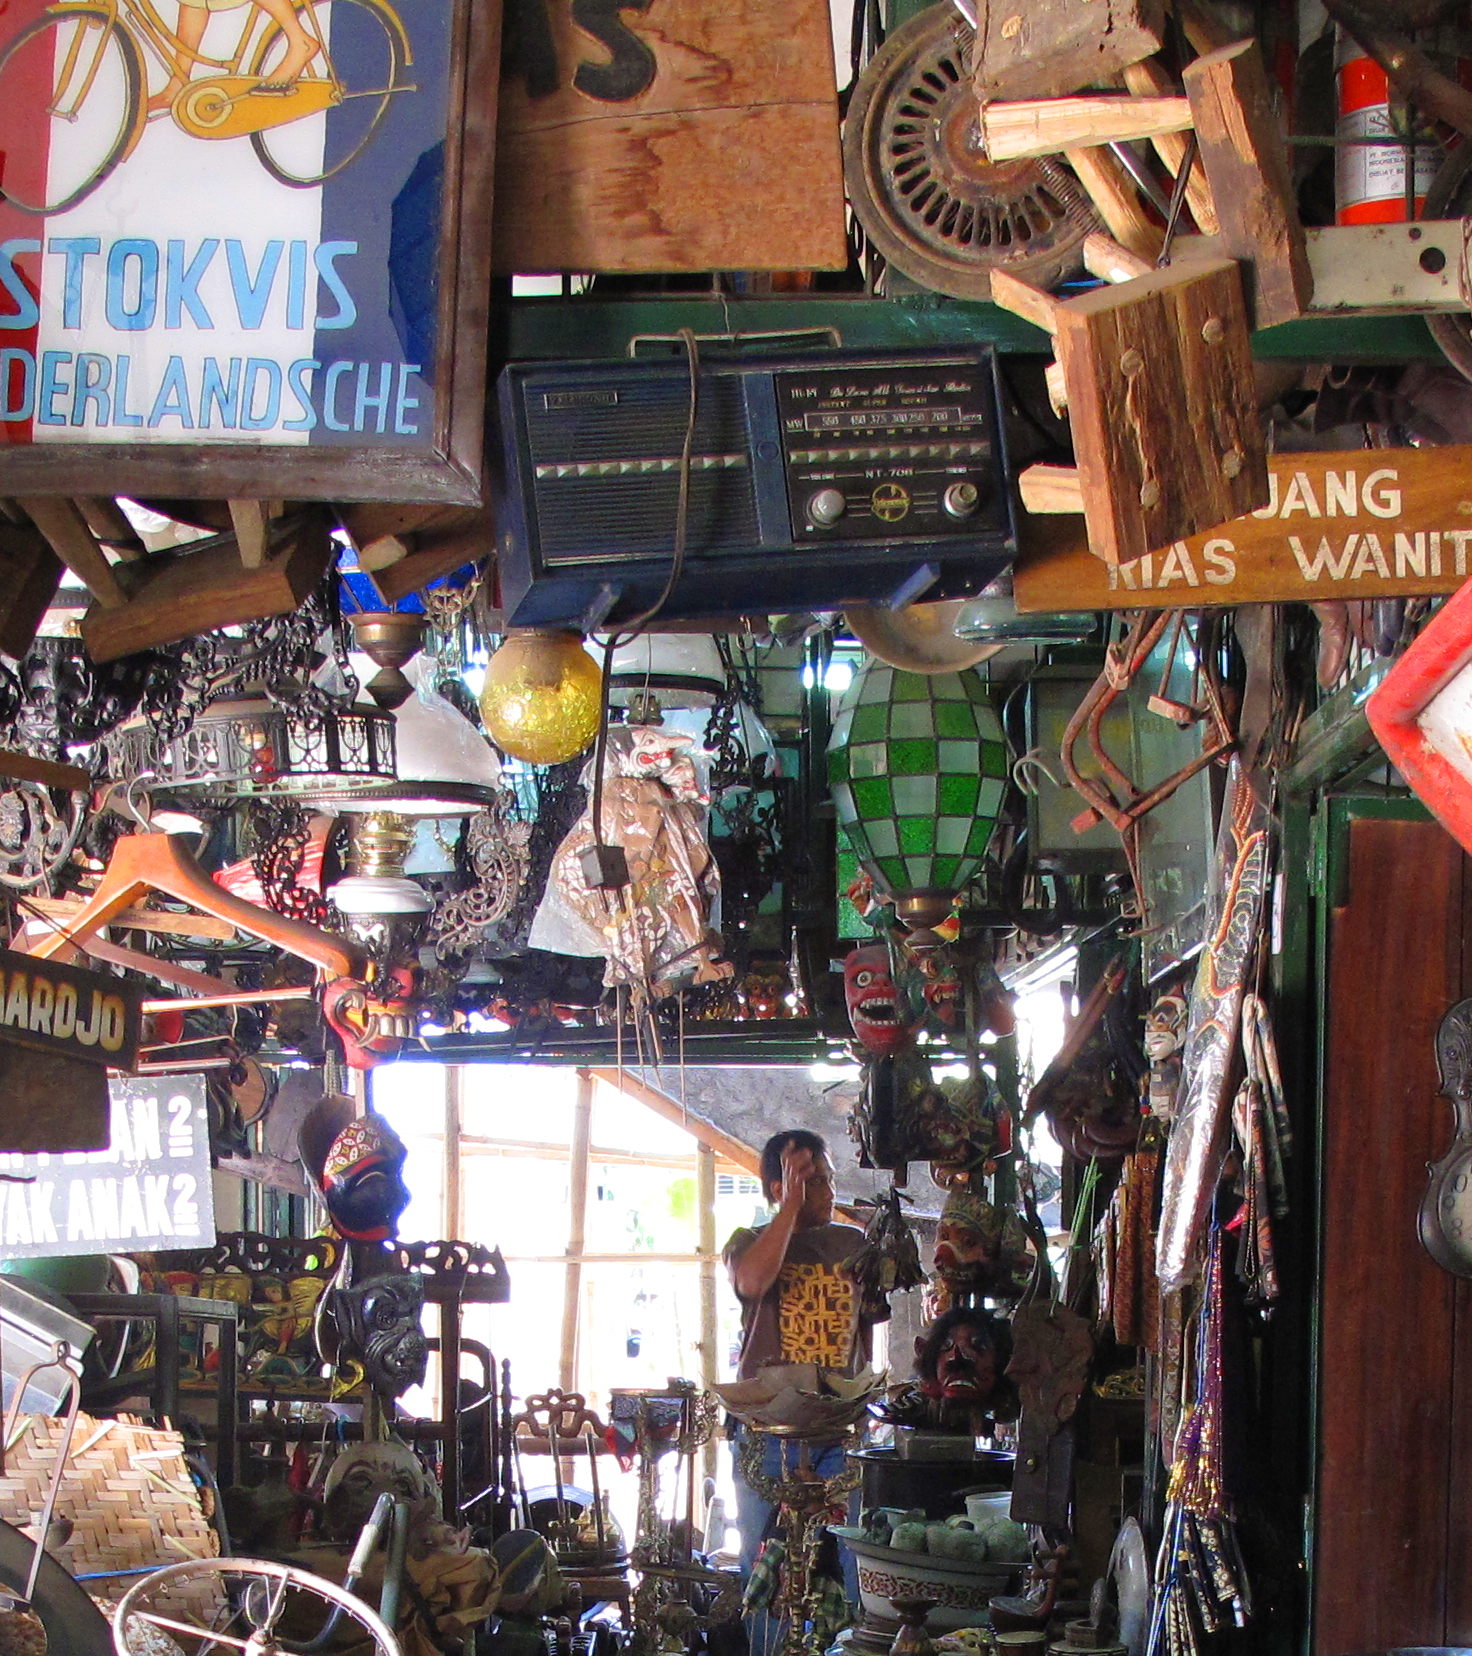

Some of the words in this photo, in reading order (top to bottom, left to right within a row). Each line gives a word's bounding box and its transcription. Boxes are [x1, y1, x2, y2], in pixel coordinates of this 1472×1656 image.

[1238, 469, 1403, 521] UANG
[780, 1297, 854, 1317] SOLO
[780, 1315, 854, 1334] UNITED
[781, 1332, 853, 1352] SOLO
